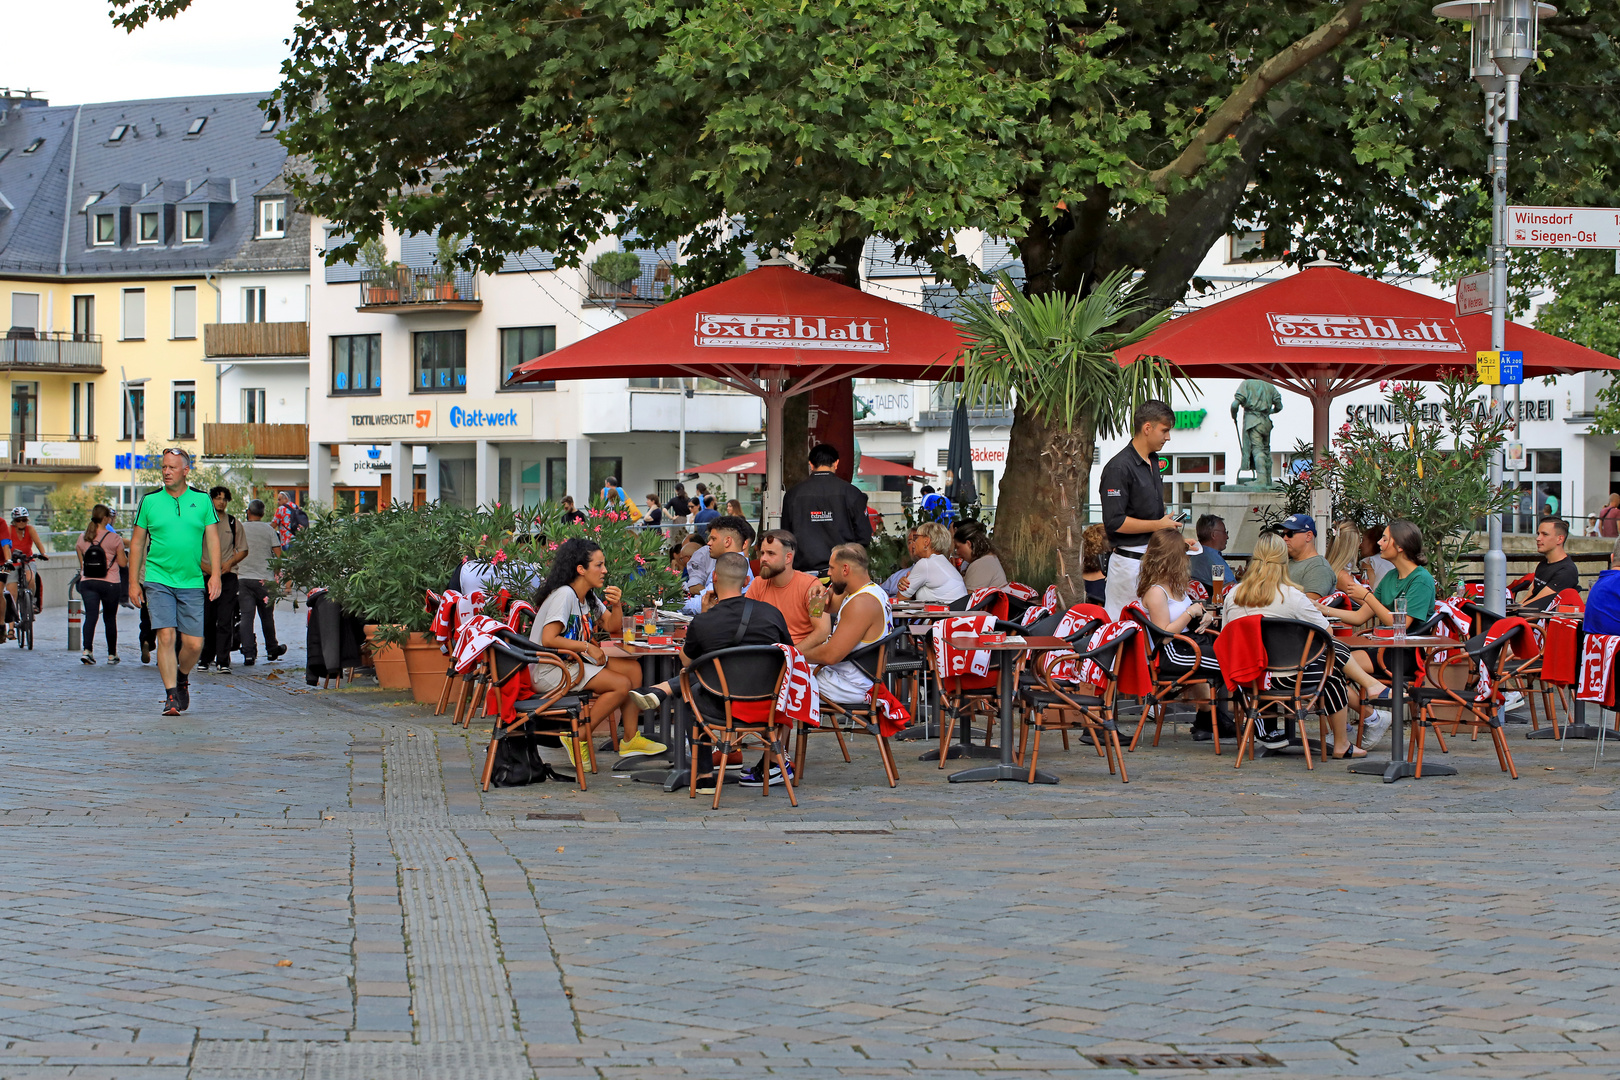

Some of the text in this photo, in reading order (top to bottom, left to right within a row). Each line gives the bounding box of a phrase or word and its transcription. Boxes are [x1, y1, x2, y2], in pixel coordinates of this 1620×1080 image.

[1515, 212, 1573, 225] Wilnsdorf
[1531, 230, 1597, 244] Siegen-Ost
[700, 317, 882, 341] extrablatt
[1275, 317, 1451, 341] extrablatt
[875, 394, 909, 409] TALENTS
[351, 410, 431, 428] TEXTILWERKSTATT 57
[970, 447, 1005, 462] Bäckerei
